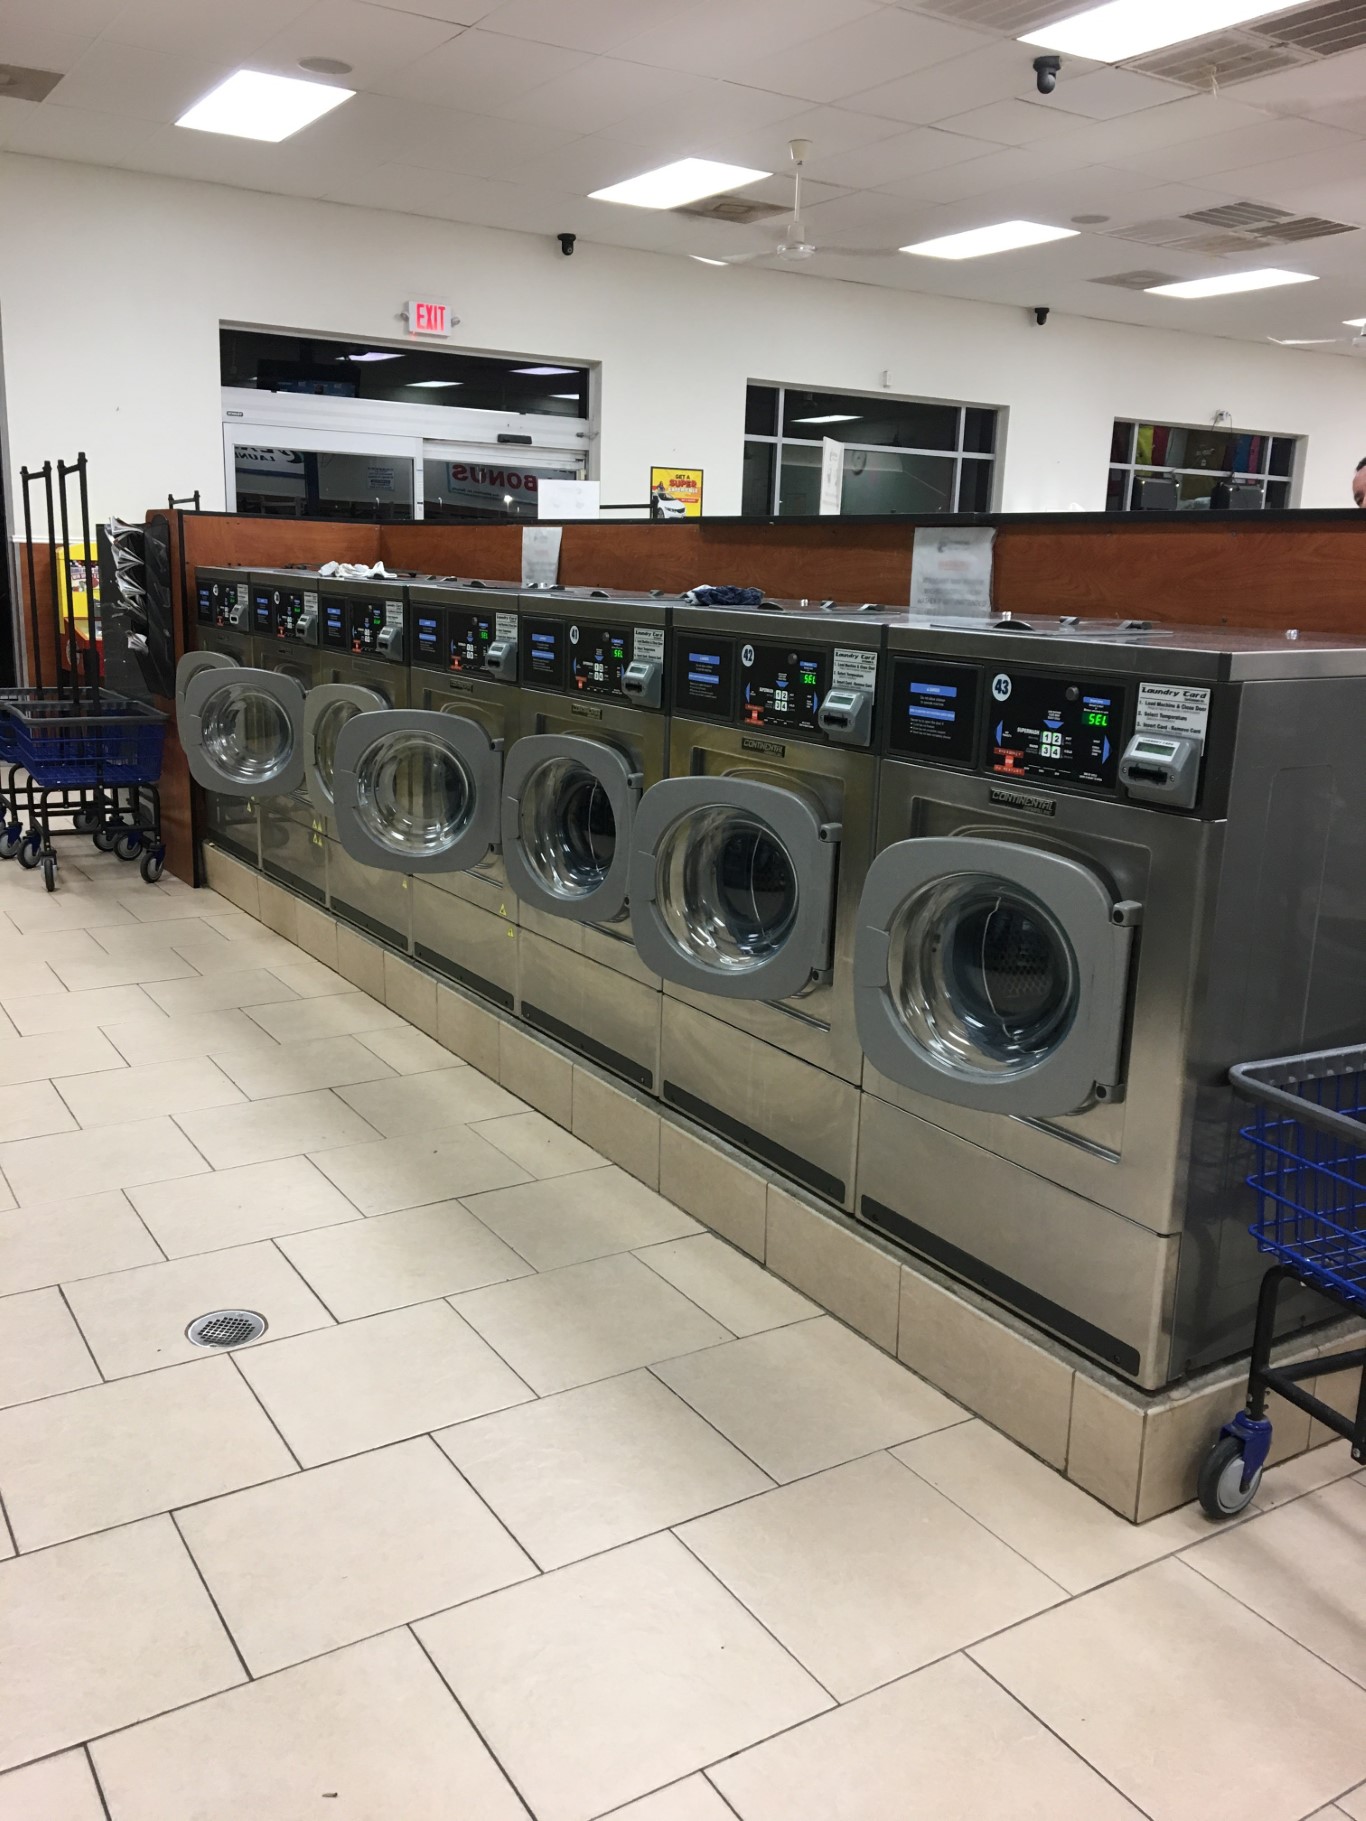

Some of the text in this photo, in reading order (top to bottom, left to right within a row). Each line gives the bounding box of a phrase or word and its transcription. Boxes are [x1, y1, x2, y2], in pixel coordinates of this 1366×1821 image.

[416, 303, 446, 331] EXIT
[669, 479, 697, 488] SUPER
[743, 648, 753, 661] 42
[804, 674, 816, 684] SEL
[994, 678, 1009, 695] 43
[1141, 686, 1207, 699] Laundry Card
[1088, 713, 1107, 726] SEL
[1160, 712, 1187, 721] Temperature
[992, 790, 1053, 811] CONTINENTAL
